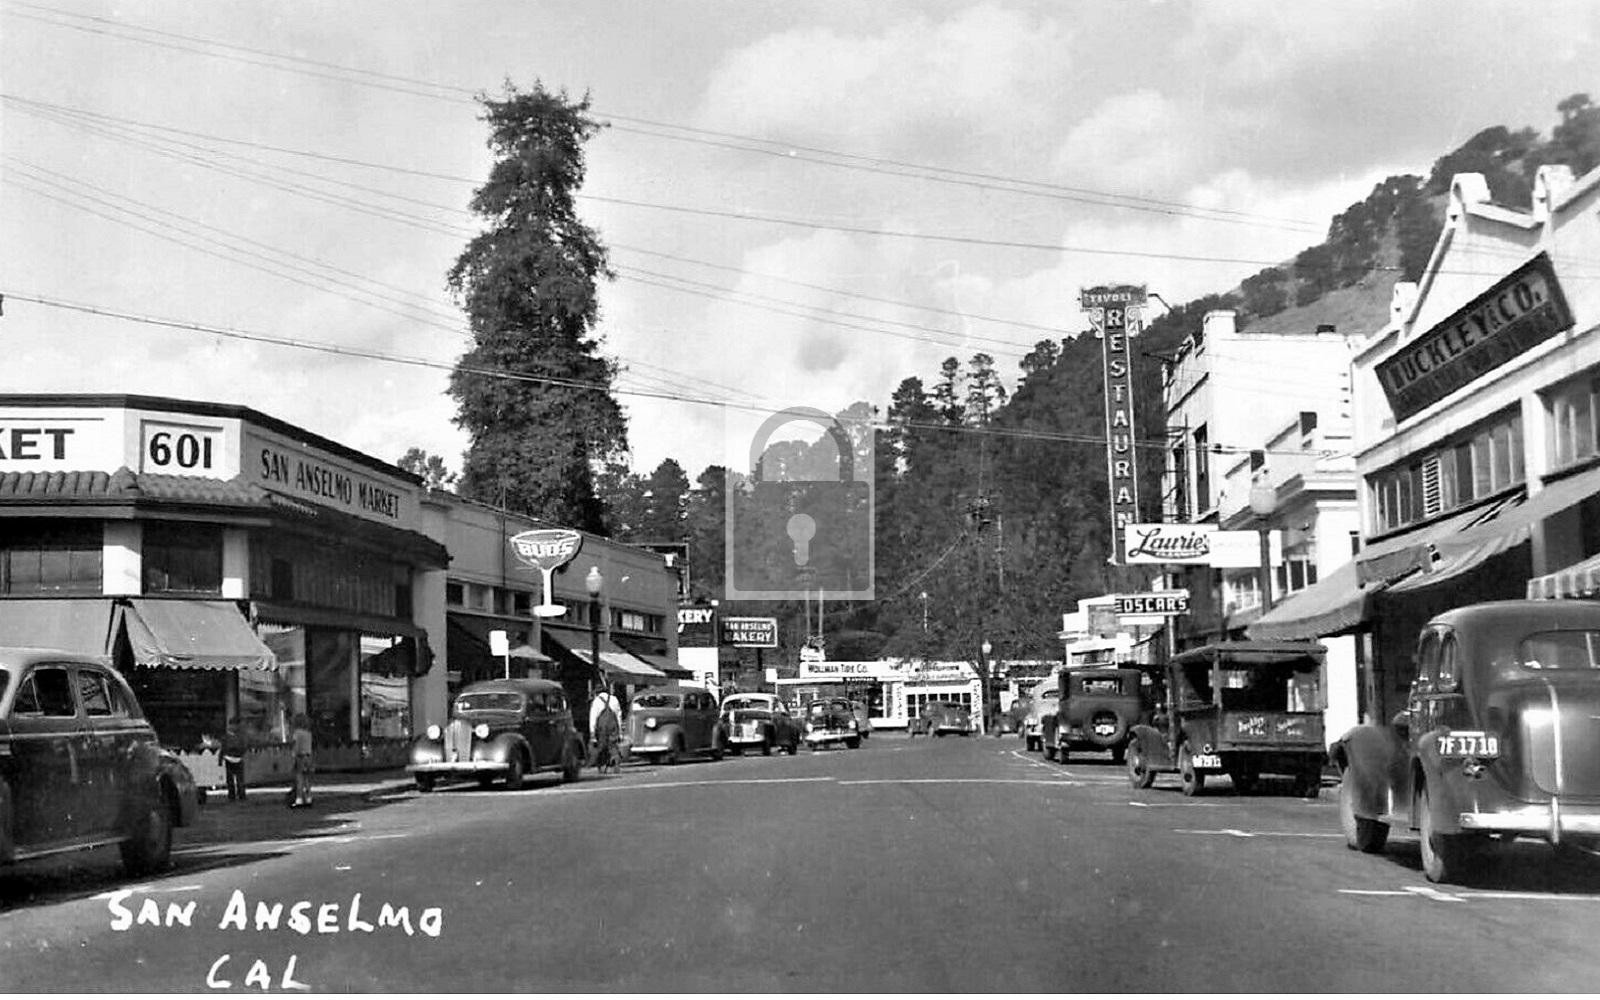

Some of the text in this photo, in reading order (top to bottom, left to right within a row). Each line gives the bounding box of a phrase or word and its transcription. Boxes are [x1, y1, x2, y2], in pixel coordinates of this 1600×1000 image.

[149, 432, 212, 469] 601
[1105, 308, 1135, 541] RESTAURAN
[261, 449, 400, 519] SAN ANSELMO MARKET
[1123, 598, 1188, 613] OSCARS
